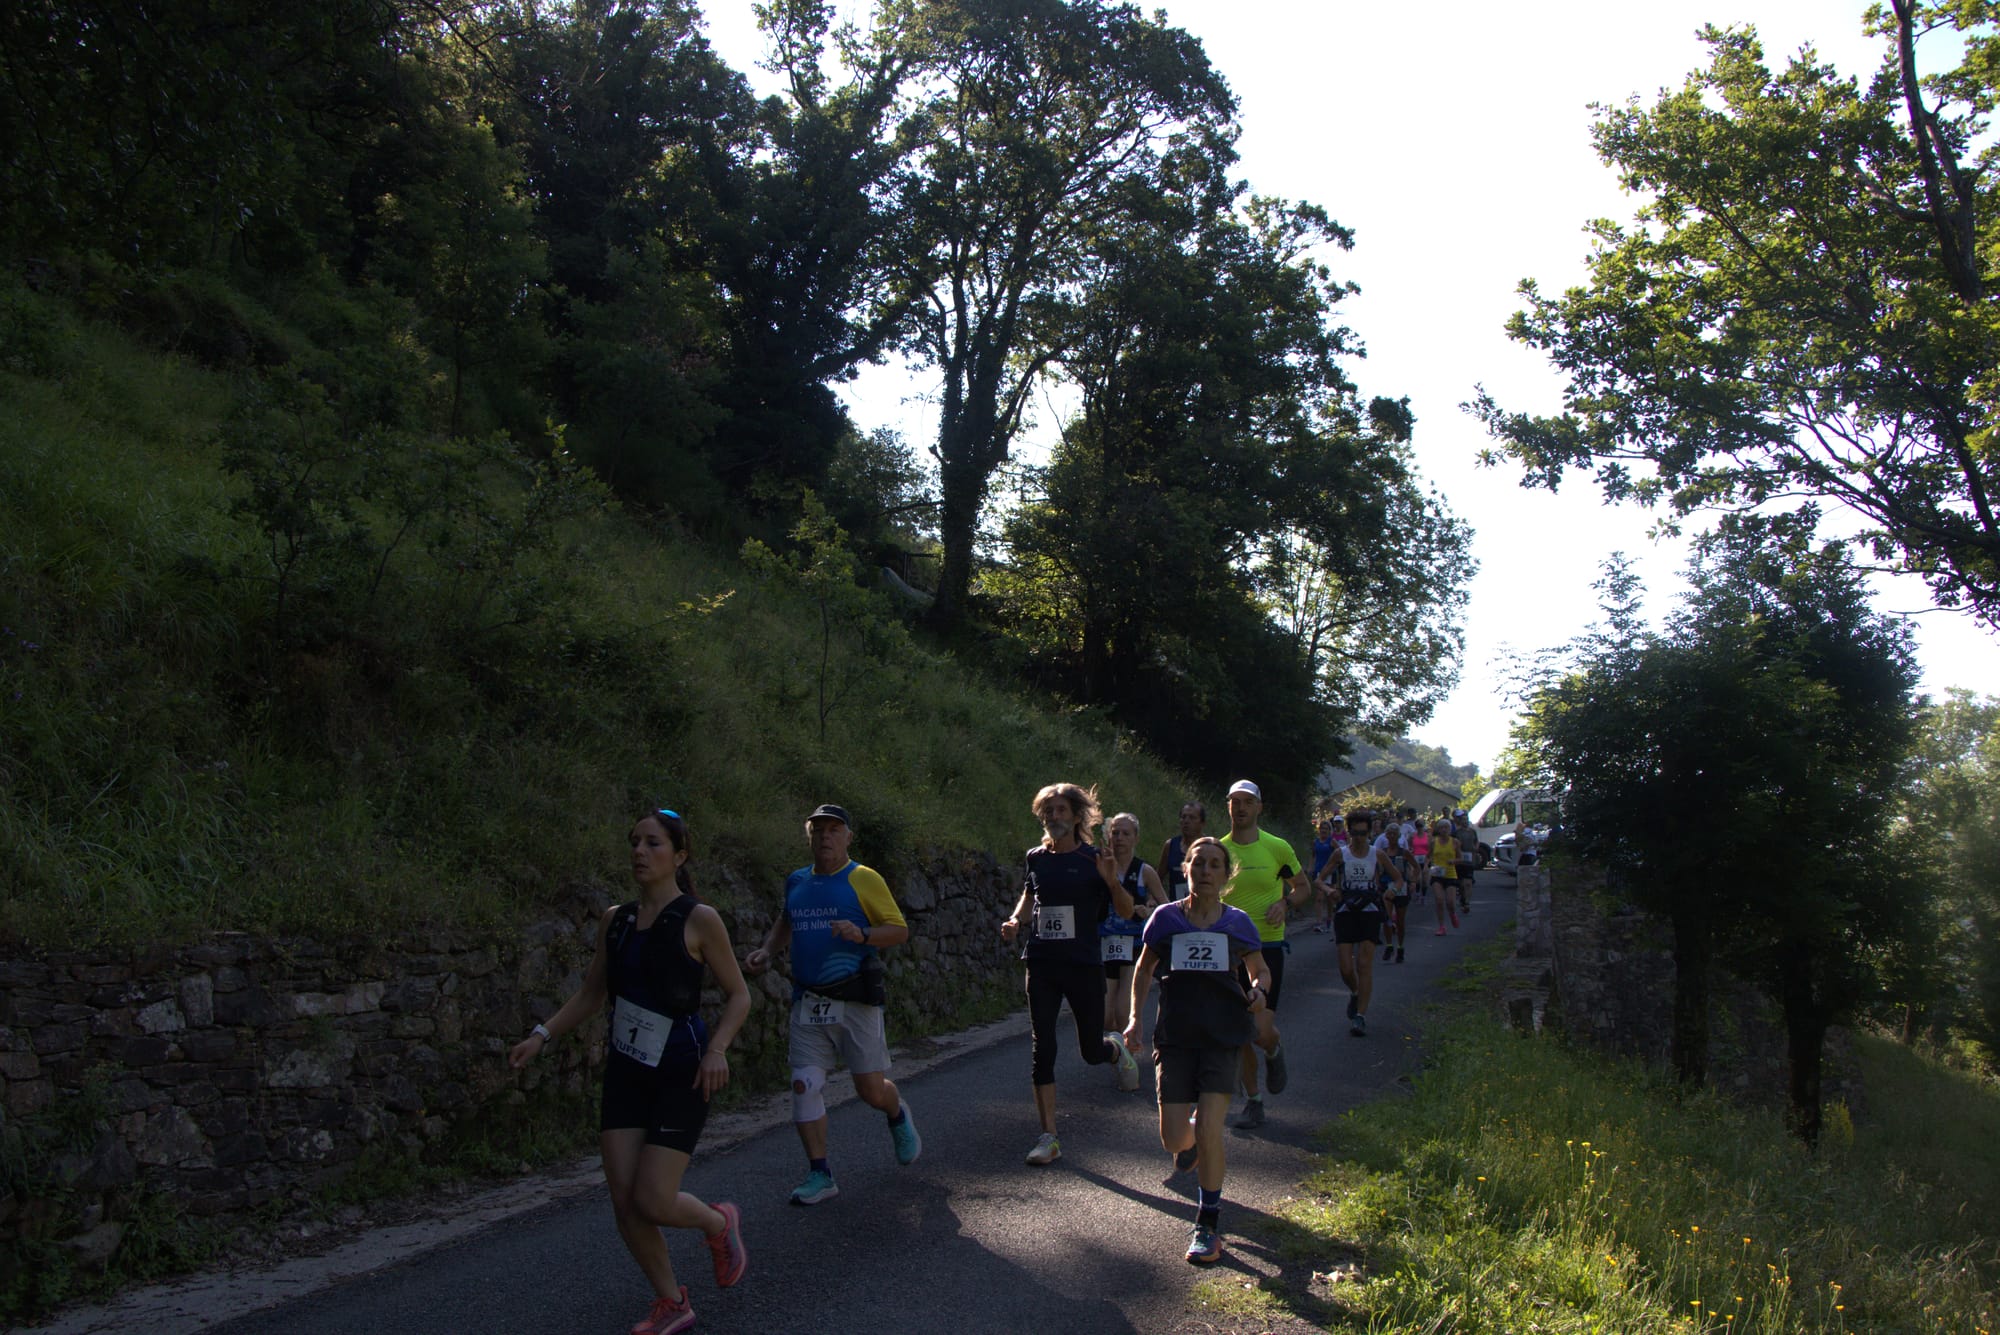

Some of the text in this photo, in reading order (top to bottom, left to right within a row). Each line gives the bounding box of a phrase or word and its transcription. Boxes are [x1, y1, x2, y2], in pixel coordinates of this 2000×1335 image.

[1353, 867, 1365, 875] 33
[791, 906, 838, 918] MACADAM
[1045, 919, 1062, 931] 46
[1108, 944, 1123, 954] 86
[1188, 946, 1213, 961] 22
[1183, 961, 1219, 969] TUFF'S
[813, 1002, 831, 1016] 47
[629, 1027, 639, 1044] 1
[615, 1038, 648, 1061] TUFF'S
